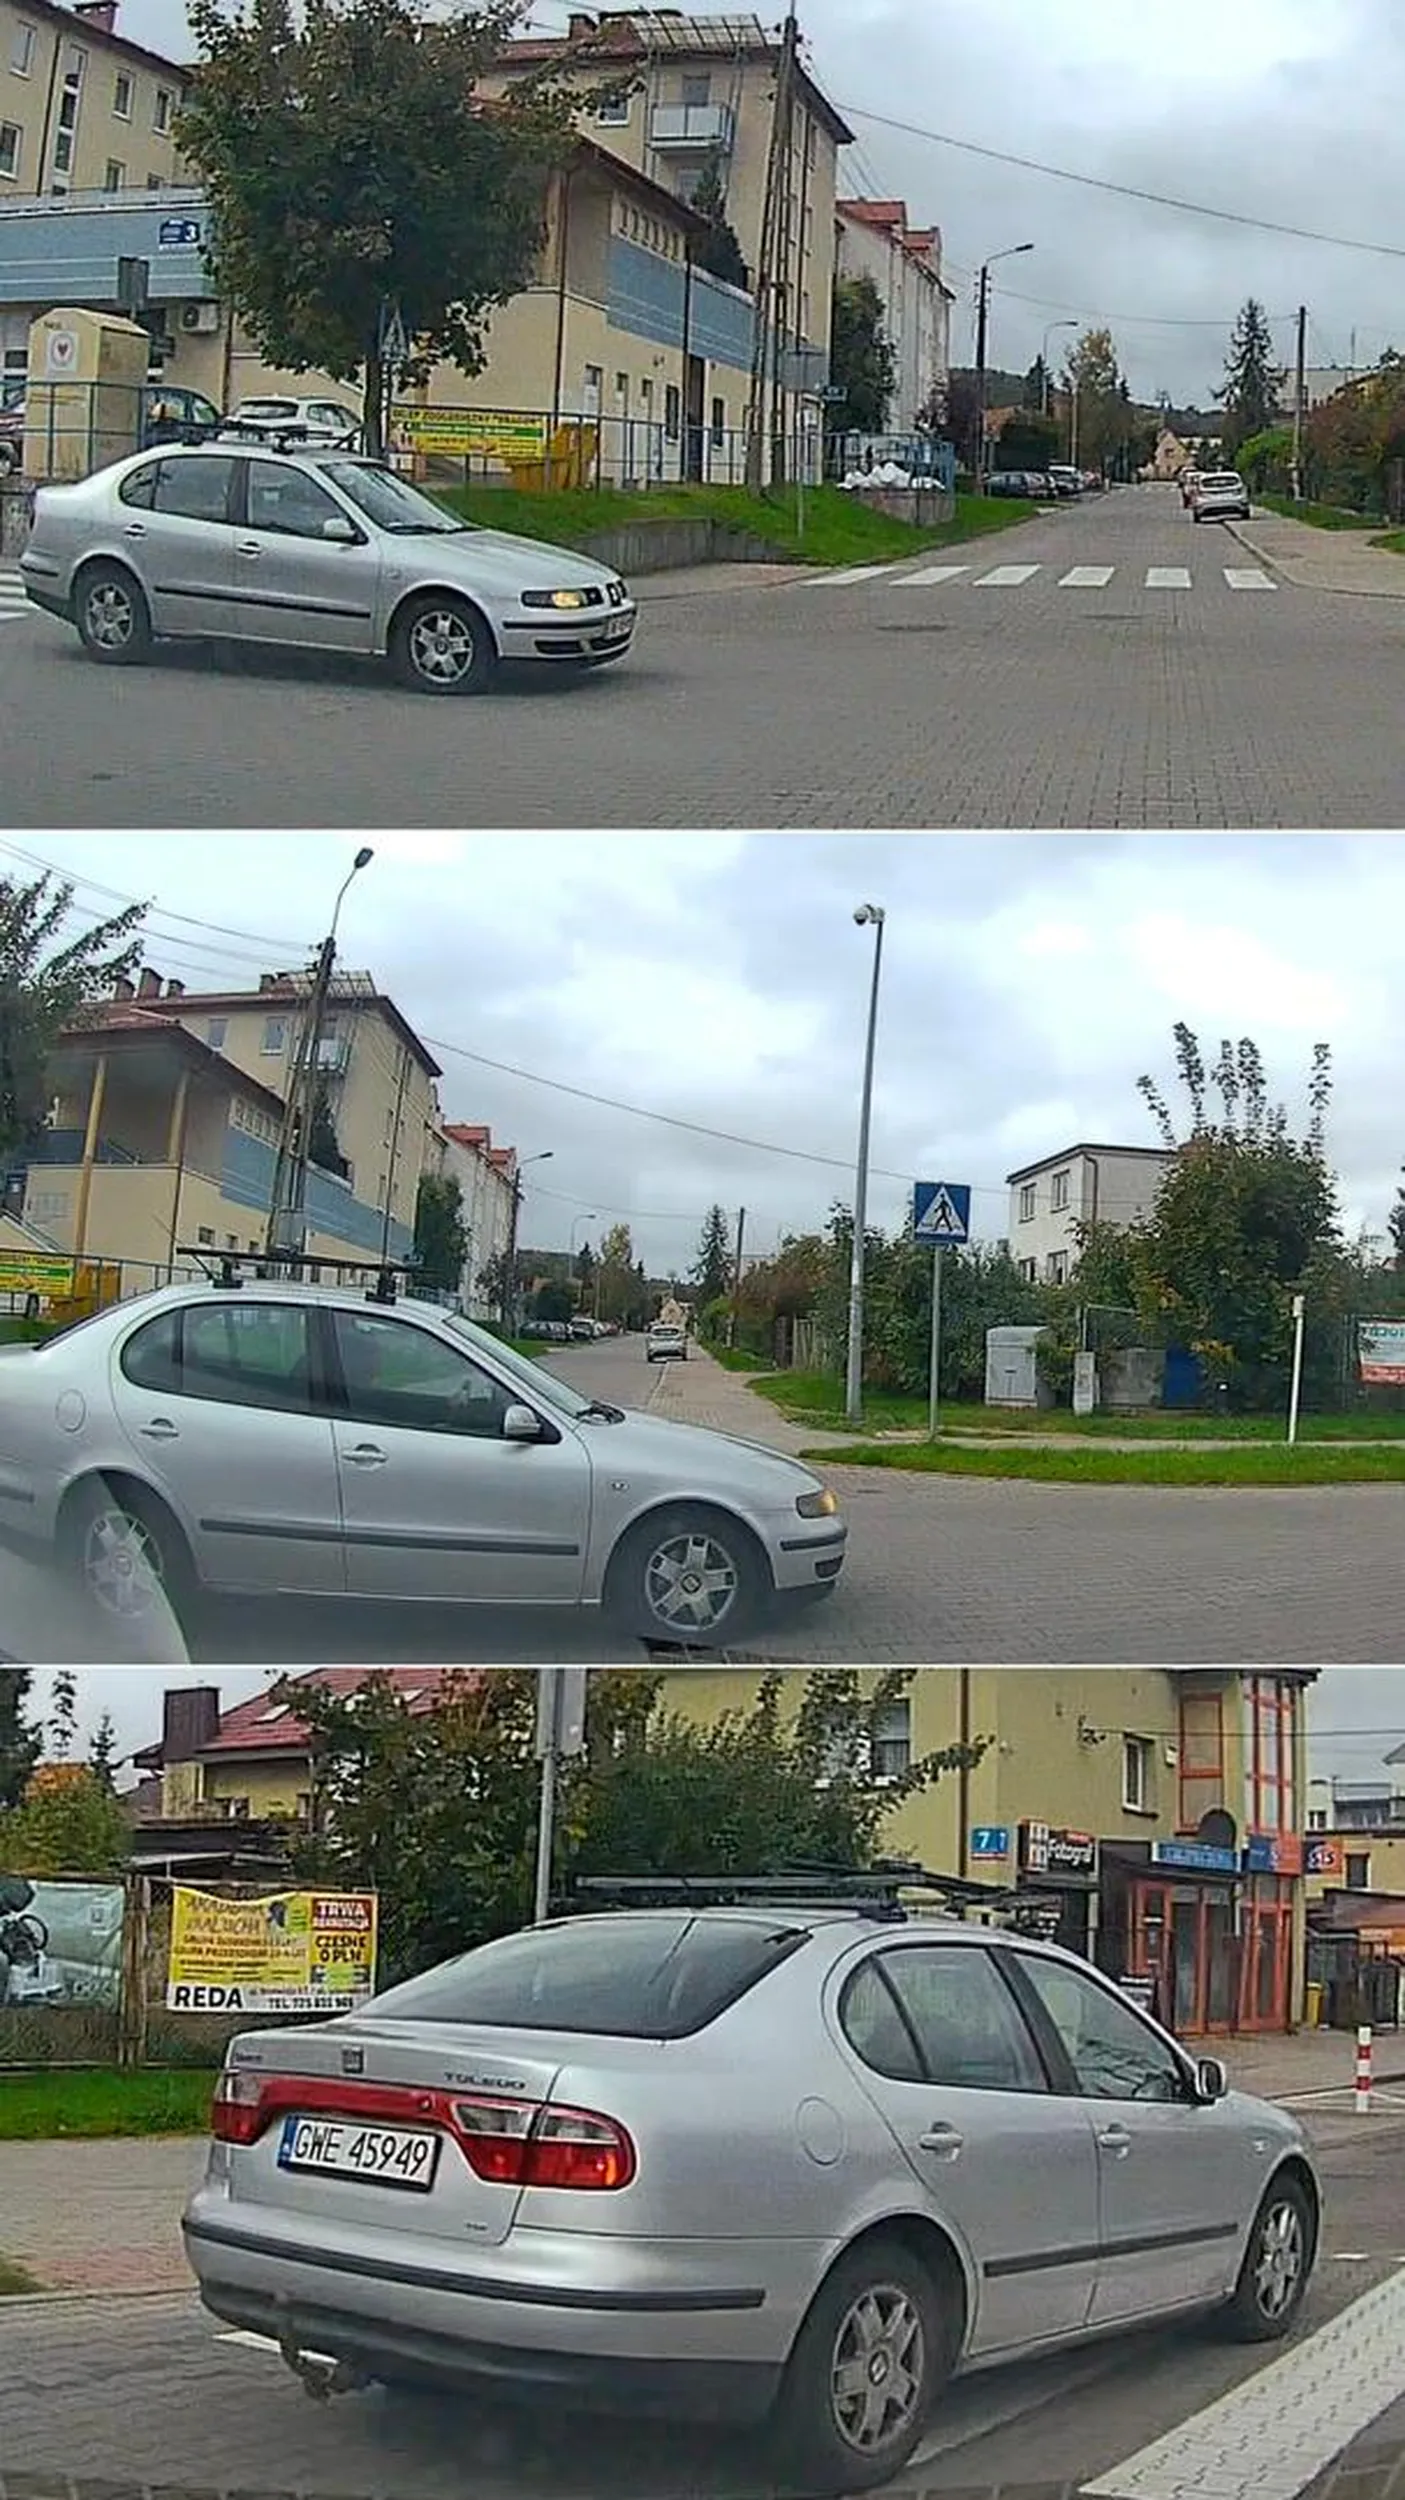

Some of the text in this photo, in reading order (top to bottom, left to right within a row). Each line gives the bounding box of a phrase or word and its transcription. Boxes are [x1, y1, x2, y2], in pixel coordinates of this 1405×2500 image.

[184, 224, 197, 241] 3
[977, 1831, 990, 1849] 7
[316, 1901, 366, 1917] TRWA
[315, 1935, 367, 1949] CZESNE
[174, 1985, 244, 2009] REDA
[443, 2071, 526, 2091] TOLEDO
[293, 2124, 429, 2177] GWE 45949
